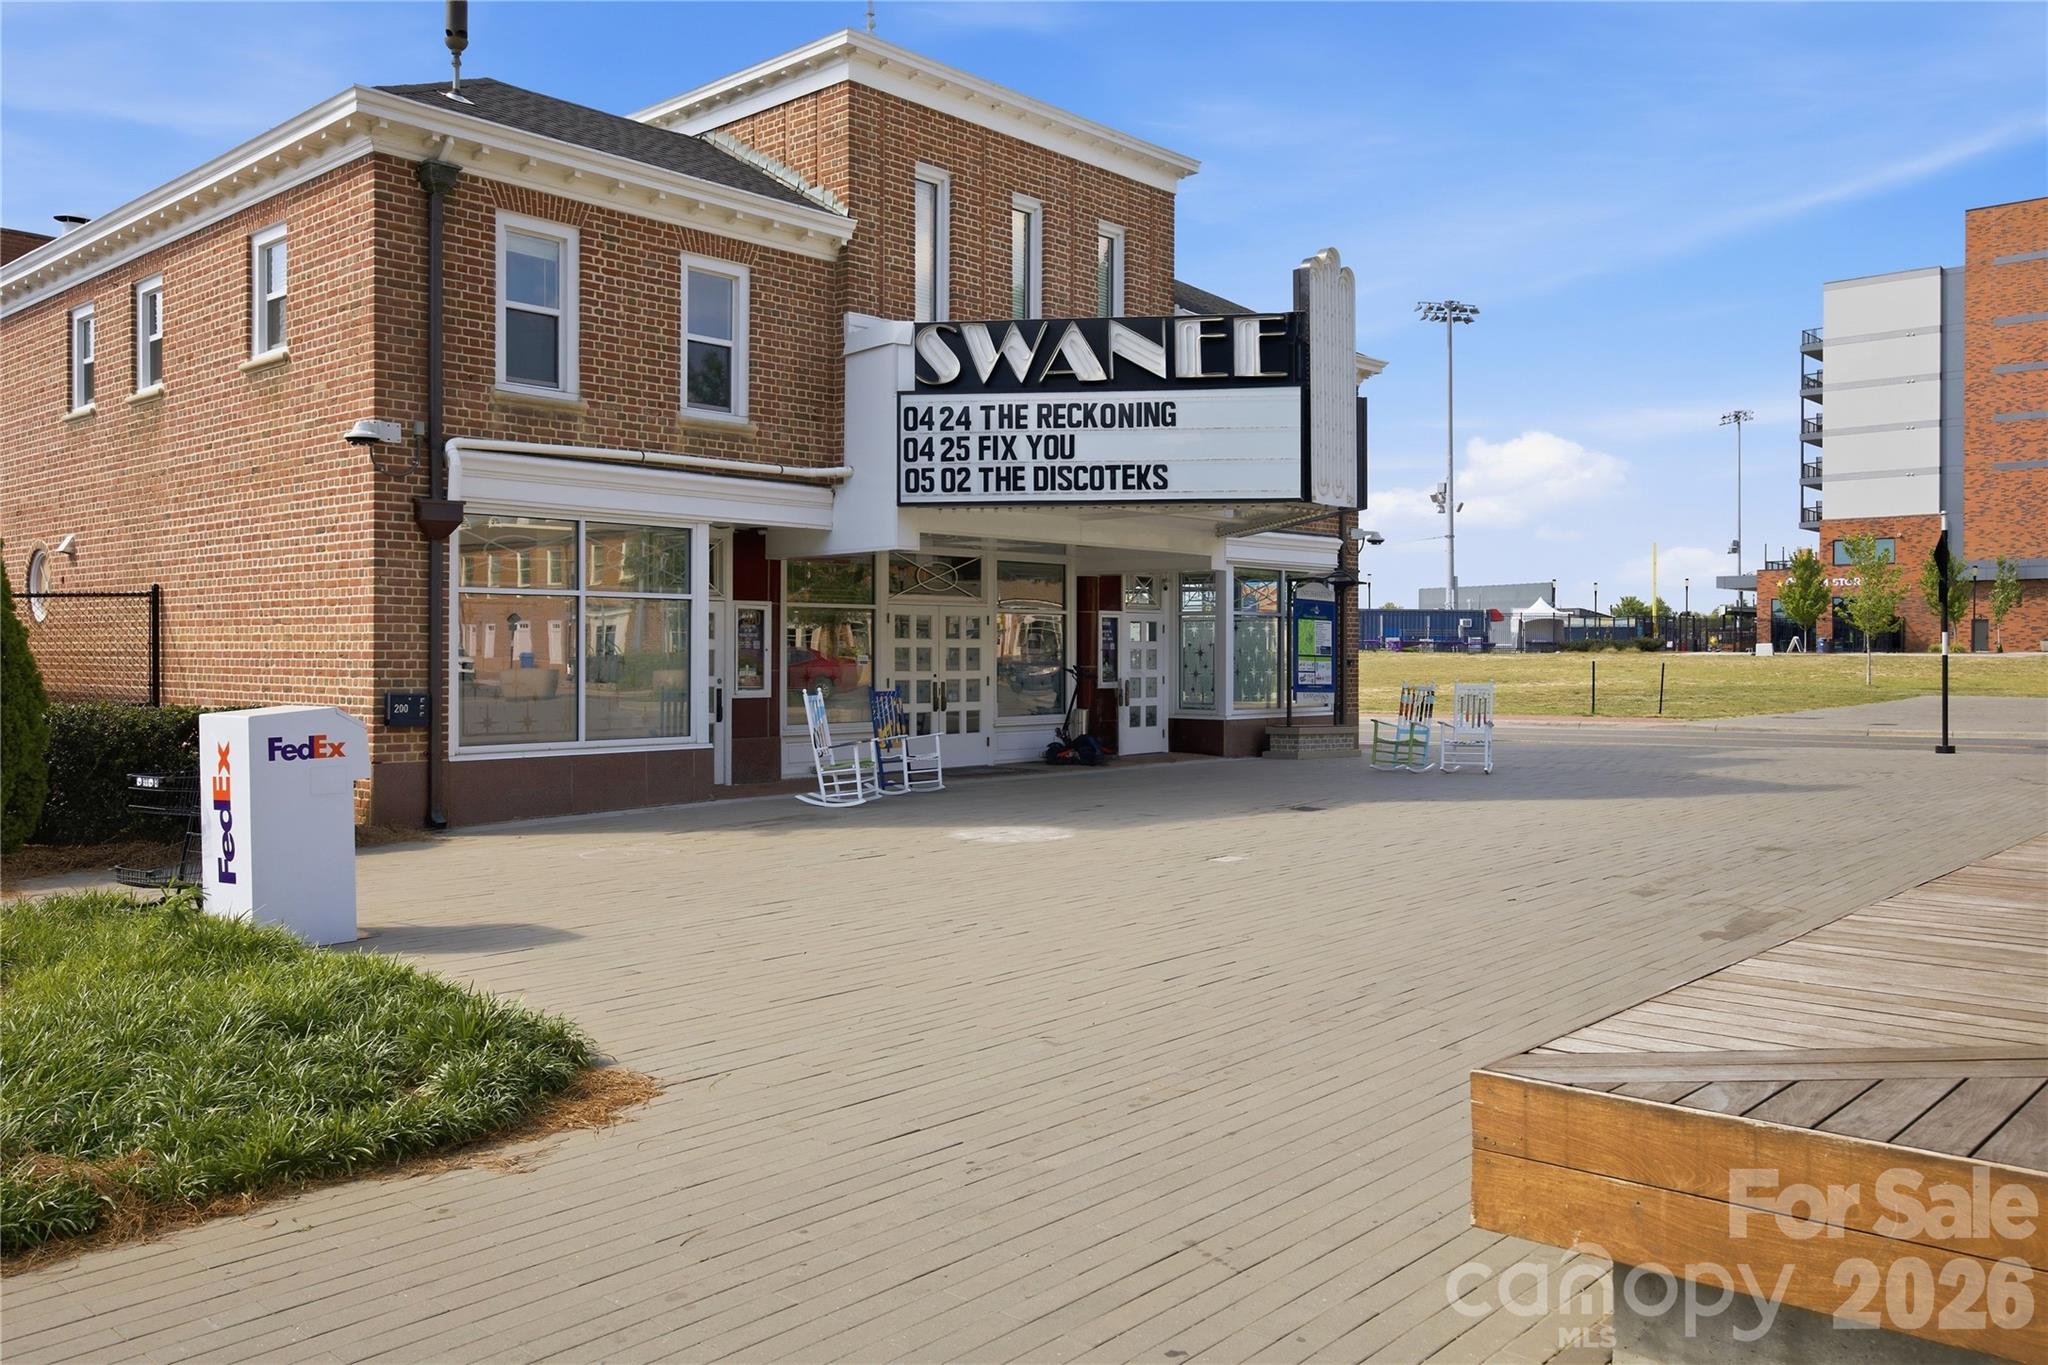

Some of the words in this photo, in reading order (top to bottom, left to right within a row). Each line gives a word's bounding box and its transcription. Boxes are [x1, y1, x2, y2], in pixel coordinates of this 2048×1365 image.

[915, 316, 1288, 385] SWANEE
[903, 406, 935, 431] 04
[939, 406, 971, 431] 24
[979, 404, 1028, 430] THE
[1036, 402, 1177, 429] RECKONING
[903, 437, 935, 462] 04
[940, 436, 970, 461] 25
[978, 435, 1016, 461] FIX
[1026, 435, 1075, 460] YOU
[905, 467, 935, 493] 05
[941, 466, 971, 492] 02
[979, 466, 1026, 492] THE
[1033, 464, 1169, 491] DISCOTEKS
[1832, 577, 1868, 586] STOR
[394, 704, 409, 714] 200
[267, 735, 346, 761] FedEx
[212, 741, 237, 885] FedEx
